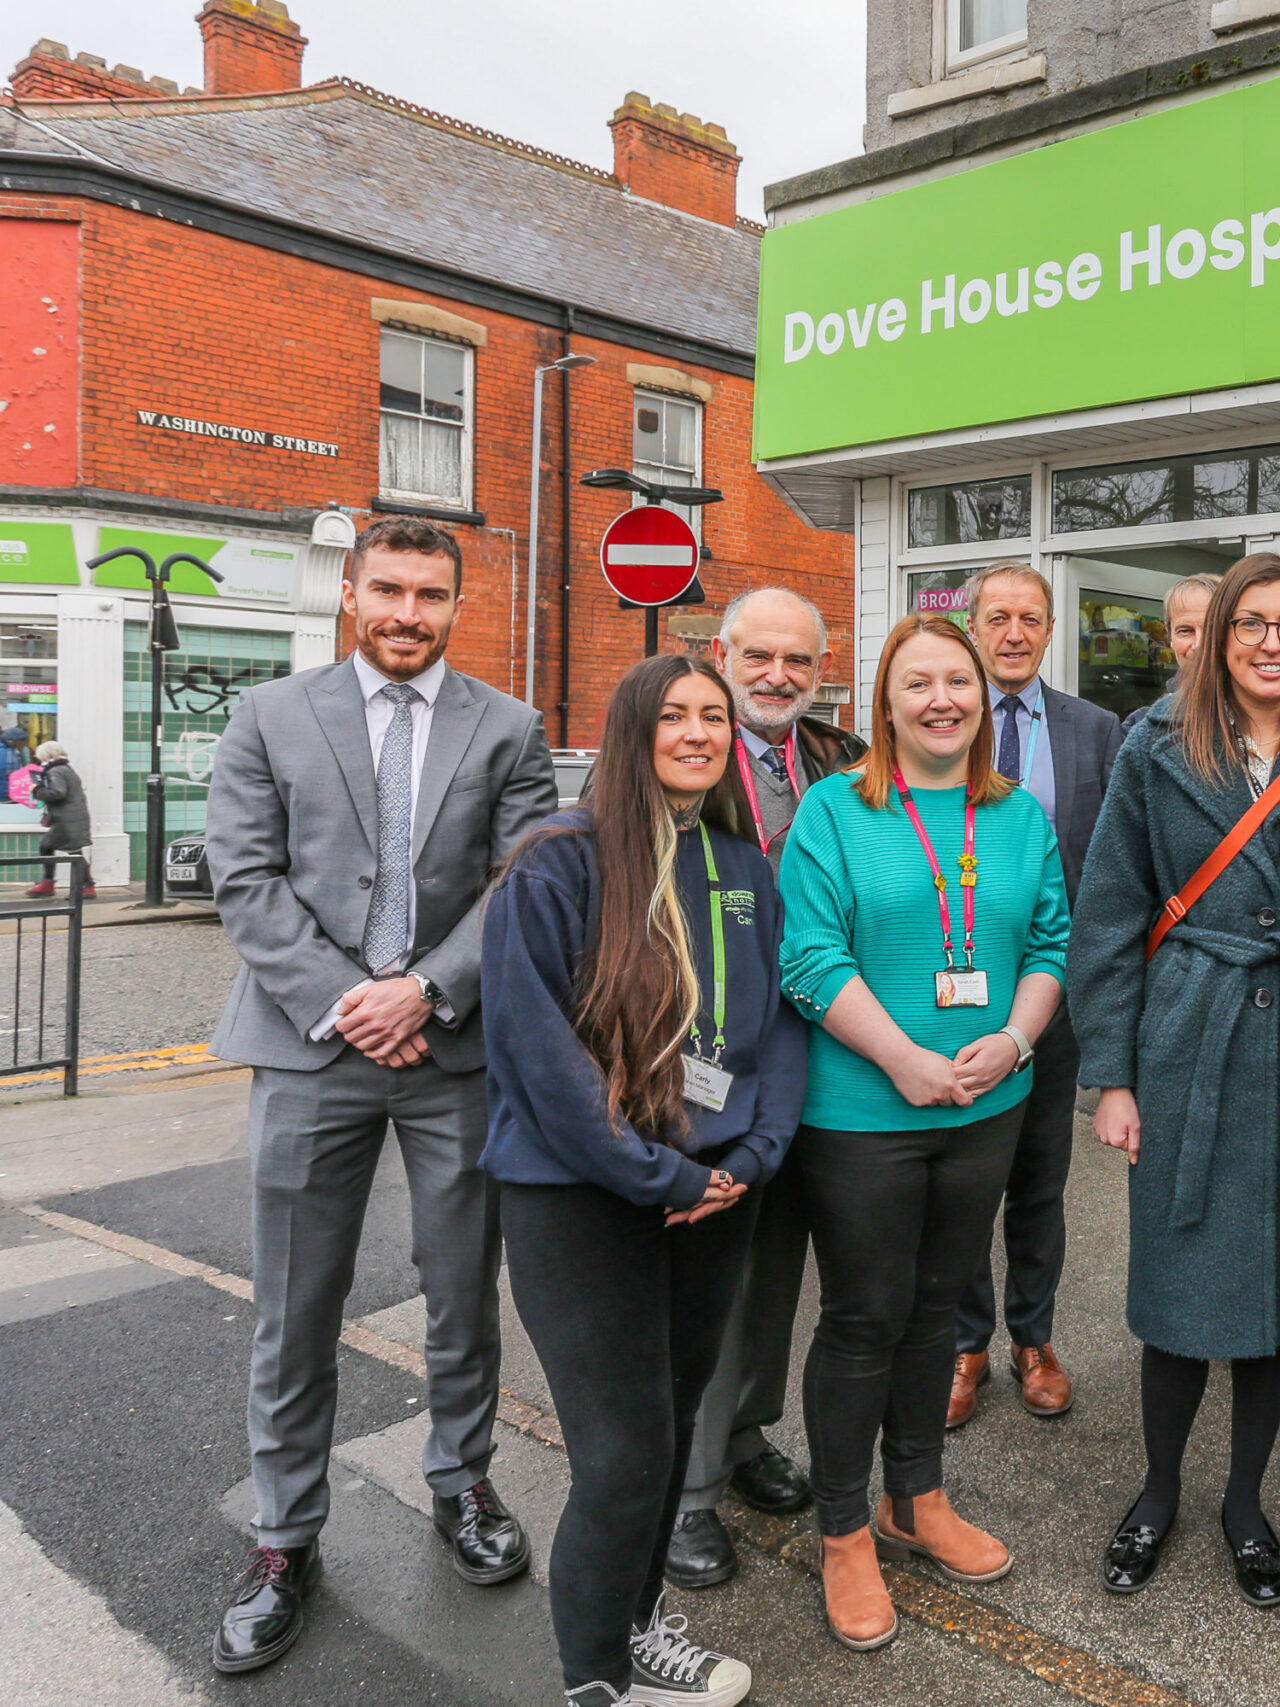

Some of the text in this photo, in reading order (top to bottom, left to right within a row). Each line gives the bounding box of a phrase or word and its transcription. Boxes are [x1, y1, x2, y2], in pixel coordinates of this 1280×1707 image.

[784, 298, 906, 363] Dove
[920, 251, 1101, 334] House
[138, 410, 338, 457] WASHINGTON STREET
[919, 591, 969, 609] BROW
